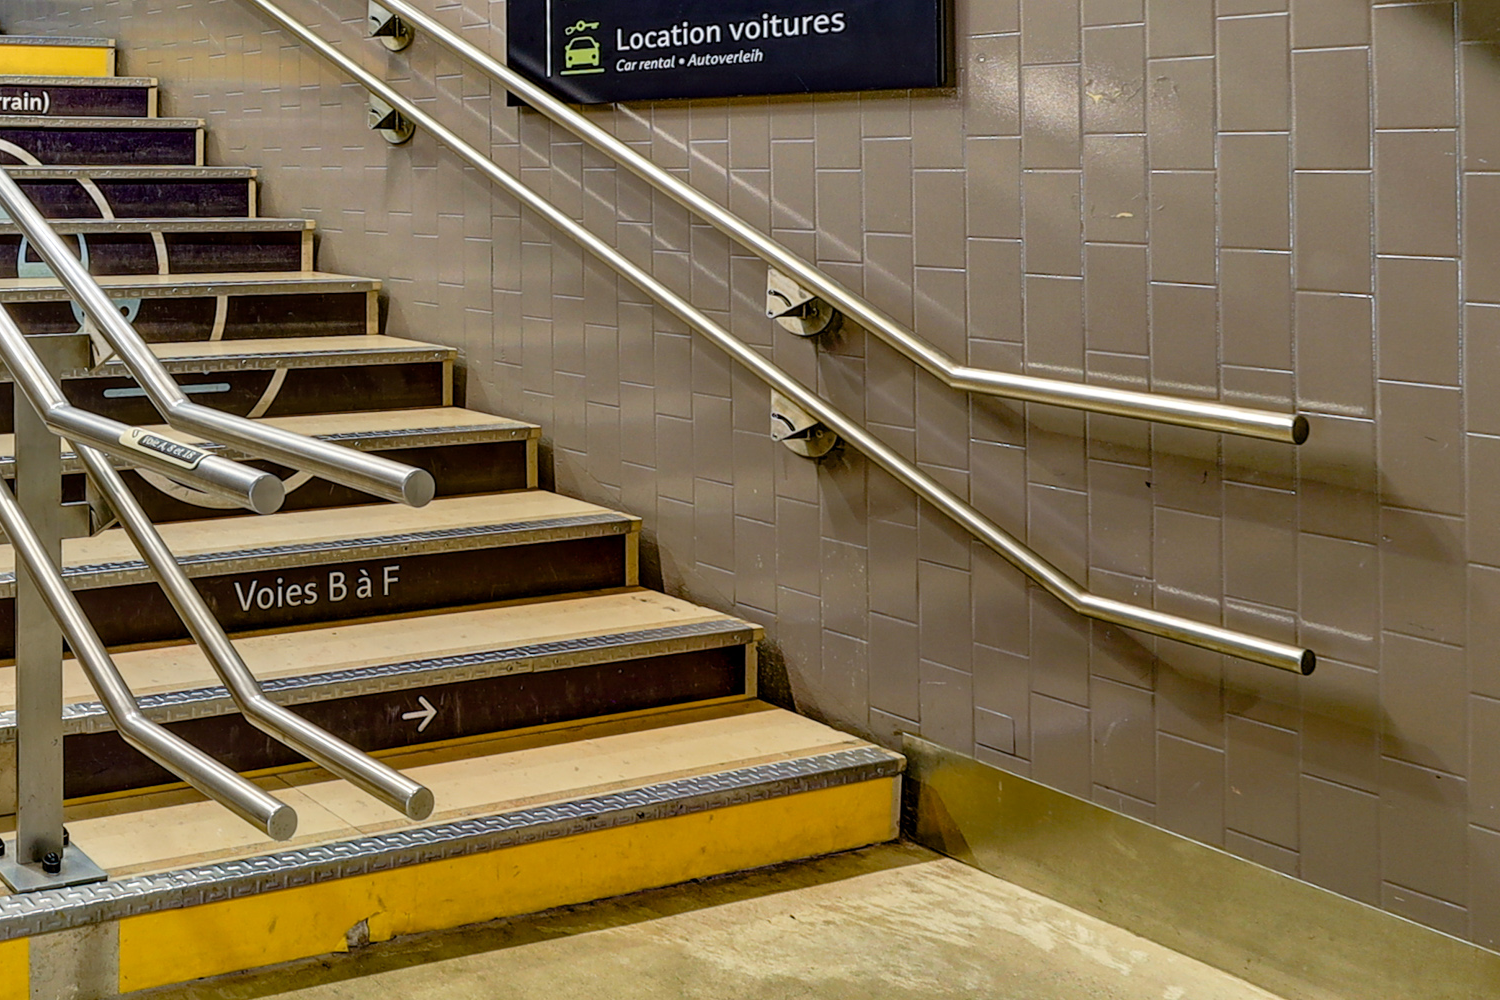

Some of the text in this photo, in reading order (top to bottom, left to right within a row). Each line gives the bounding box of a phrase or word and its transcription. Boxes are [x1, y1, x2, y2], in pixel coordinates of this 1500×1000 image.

[616, 11, 846, 51] Location voitures
[616, 48, 764, 72] Car rental Autoverleih
[233, 565, 400, 612] Voies B à F
